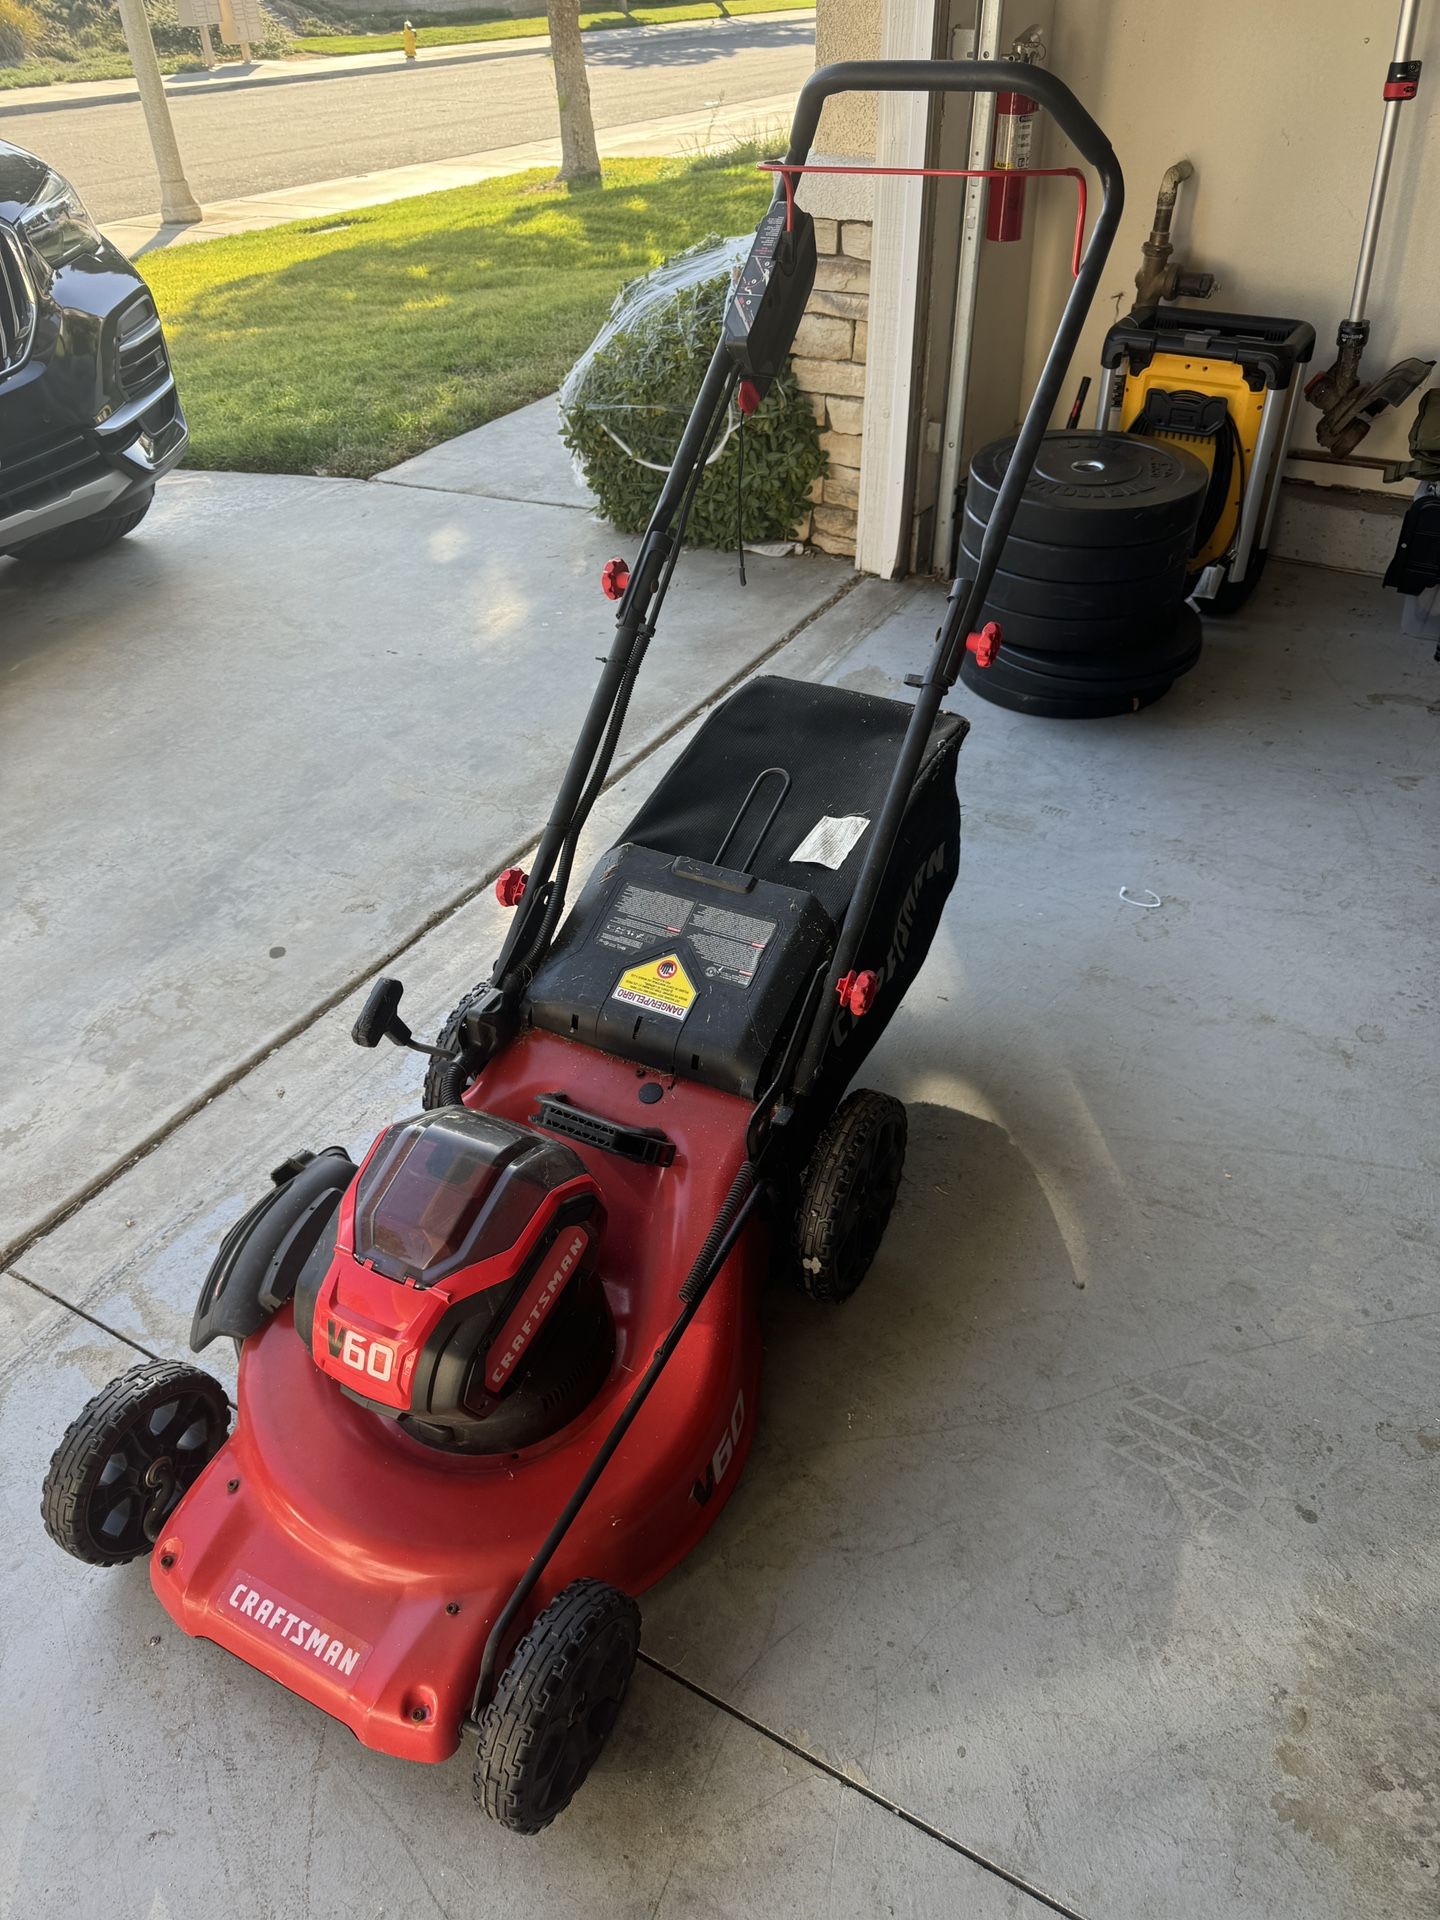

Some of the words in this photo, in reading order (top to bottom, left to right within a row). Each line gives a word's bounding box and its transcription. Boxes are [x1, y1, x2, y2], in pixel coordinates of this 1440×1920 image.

[617, 988, 685, 1016] DANGER/PELIGRO
[327, 1318, 395, 1383] V60
[490, 1236, 583, 1384] CRAFTSMAN
[689, 1388, 745, 1508] V60
[228, 1583, 361, 1676] CRAFTSMAN
